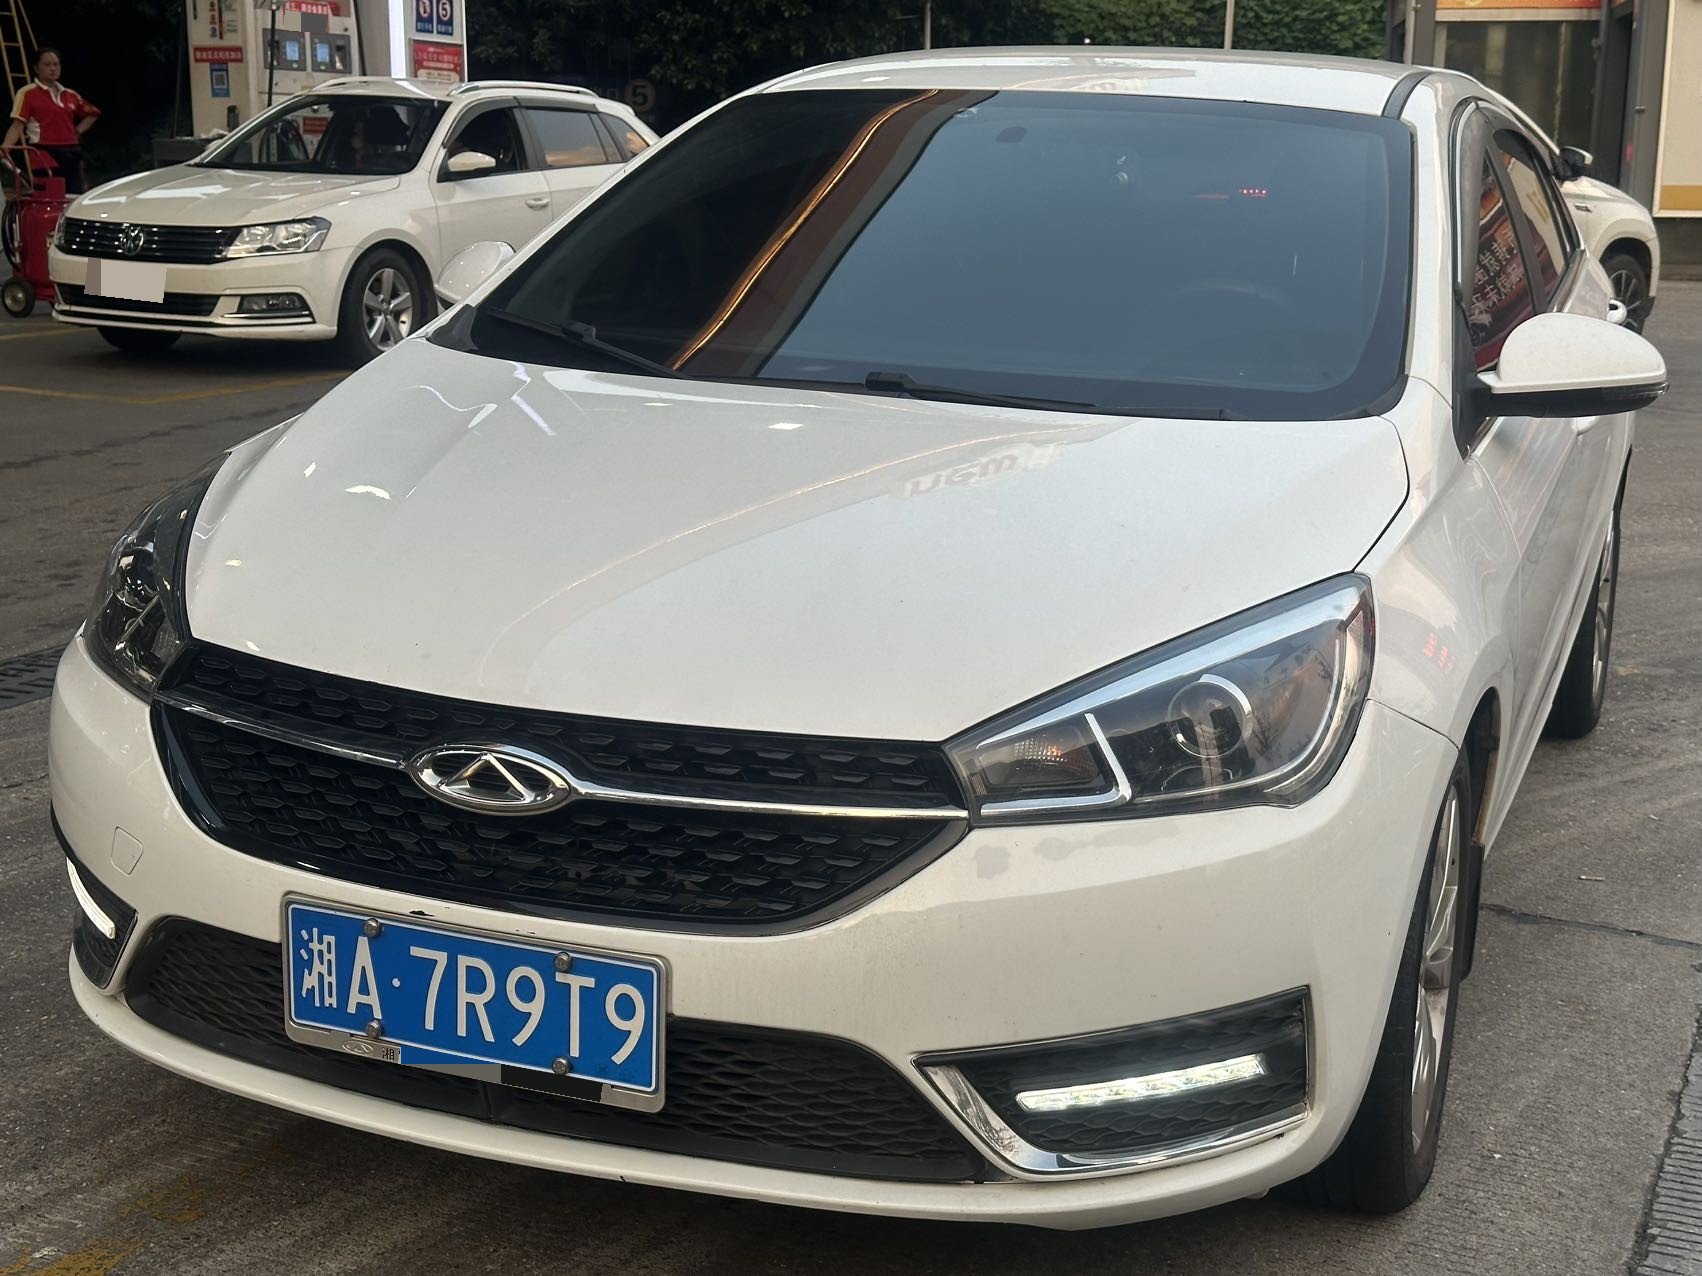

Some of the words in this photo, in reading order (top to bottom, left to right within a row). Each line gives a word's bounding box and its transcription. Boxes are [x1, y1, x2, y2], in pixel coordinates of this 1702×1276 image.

[441, 2, 449, 18] 5
[631, 85, 649, 106] 5
[299, 927, 646, 1066] 湘A·7R9T9
